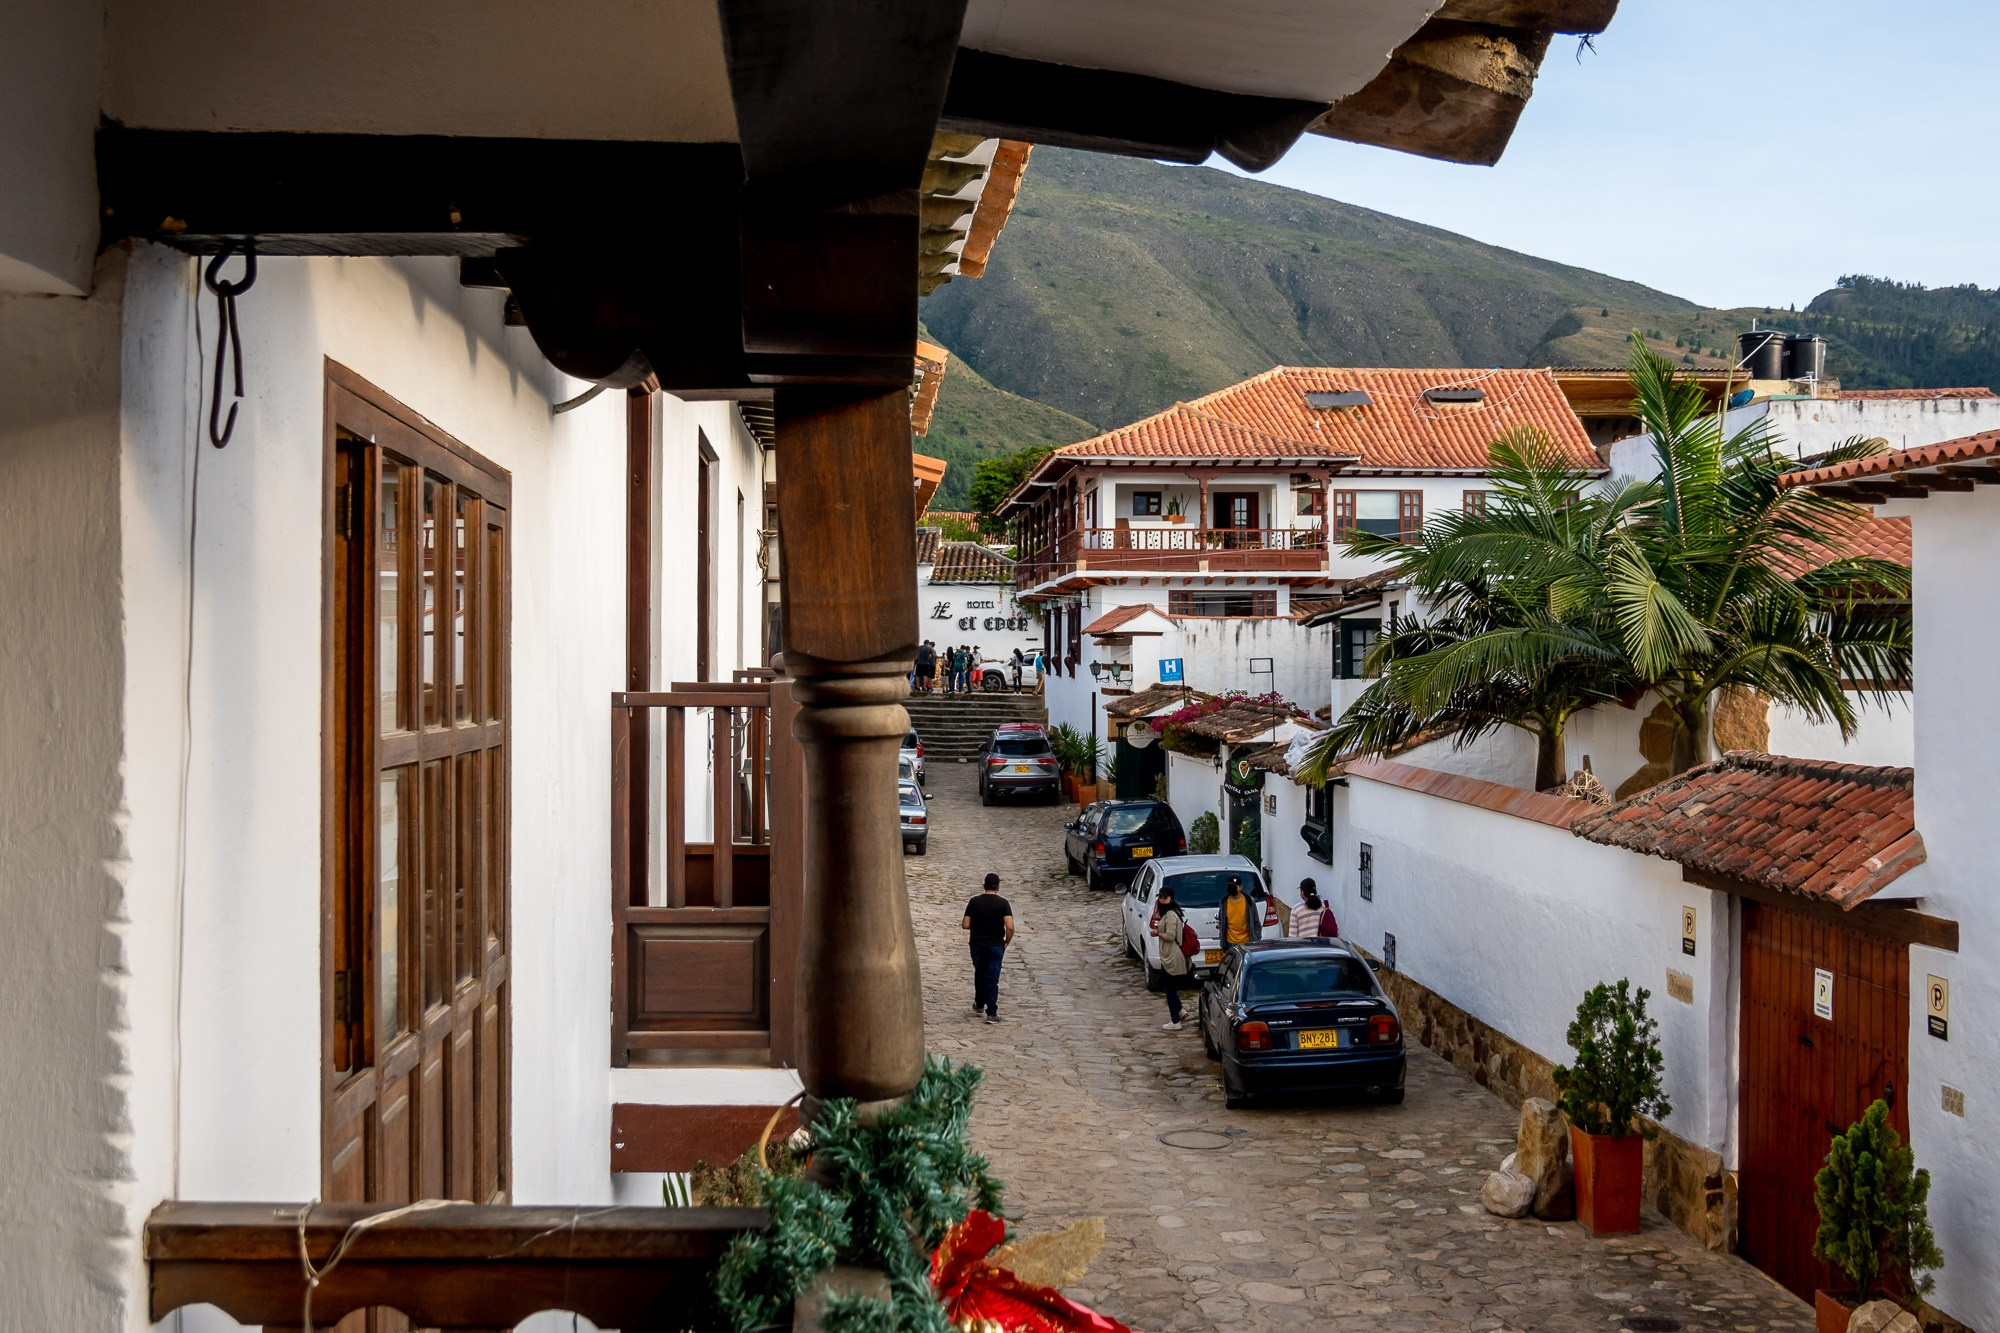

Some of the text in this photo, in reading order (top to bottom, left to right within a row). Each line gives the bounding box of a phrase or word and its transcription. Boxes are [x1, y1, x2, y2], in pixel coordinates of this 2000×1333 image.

[966, 601, 995, 609] HOTEL
[983, 616, 1029, 631] EDEN
[1165, 660, 1177, 674] H
